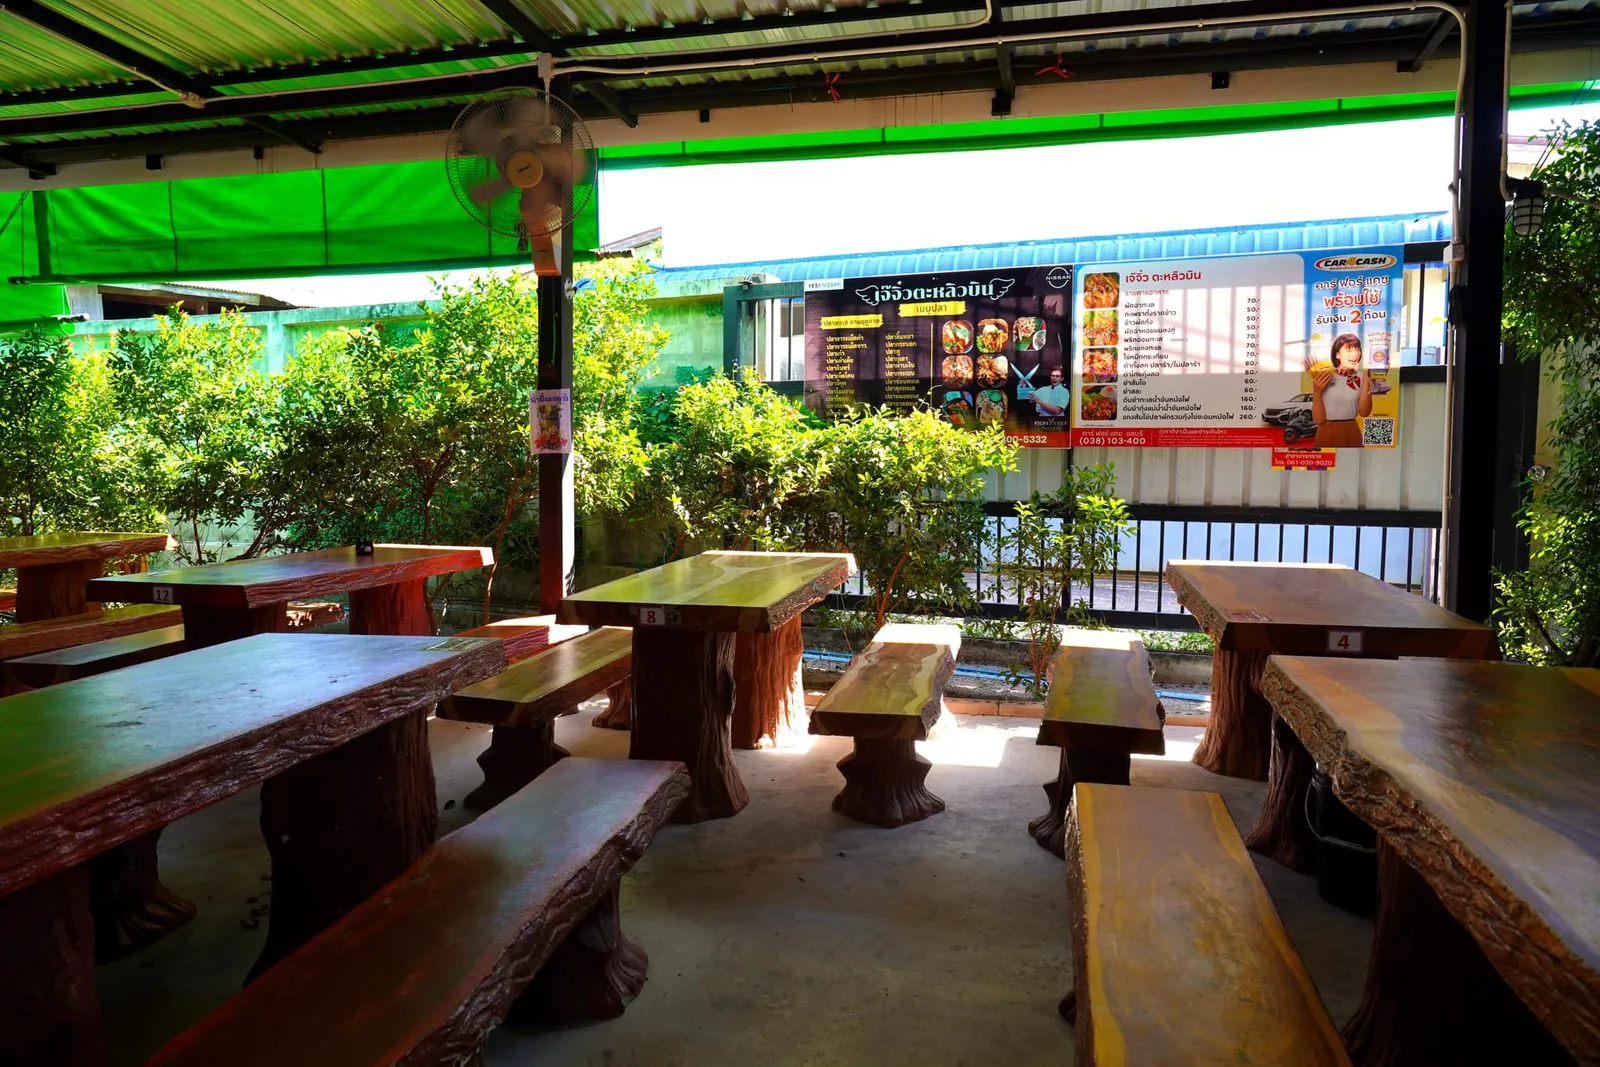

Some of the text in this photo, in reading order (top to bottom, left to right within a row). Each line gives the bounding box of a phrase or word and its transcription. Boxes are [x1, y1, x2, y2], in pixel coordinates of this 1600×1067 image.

[1152, 270, 1202, 281] ตะหลิวบิน
[1315, 276, 1389, 289] คาร์ ฟอร์ แคช
[1324, 288, 1381, 307] พร้อมใช้
[916, 304, 947, 315] เมนูปลา
[1316, 310, 1386, 324] รับเงิน 2 ก้อน
[1079, 437, 1105, 446] (038)
[156, 589, 170, 601] 12
[647, 610, 656, 624] 8
[1337, 635, 1350, 650] 4
